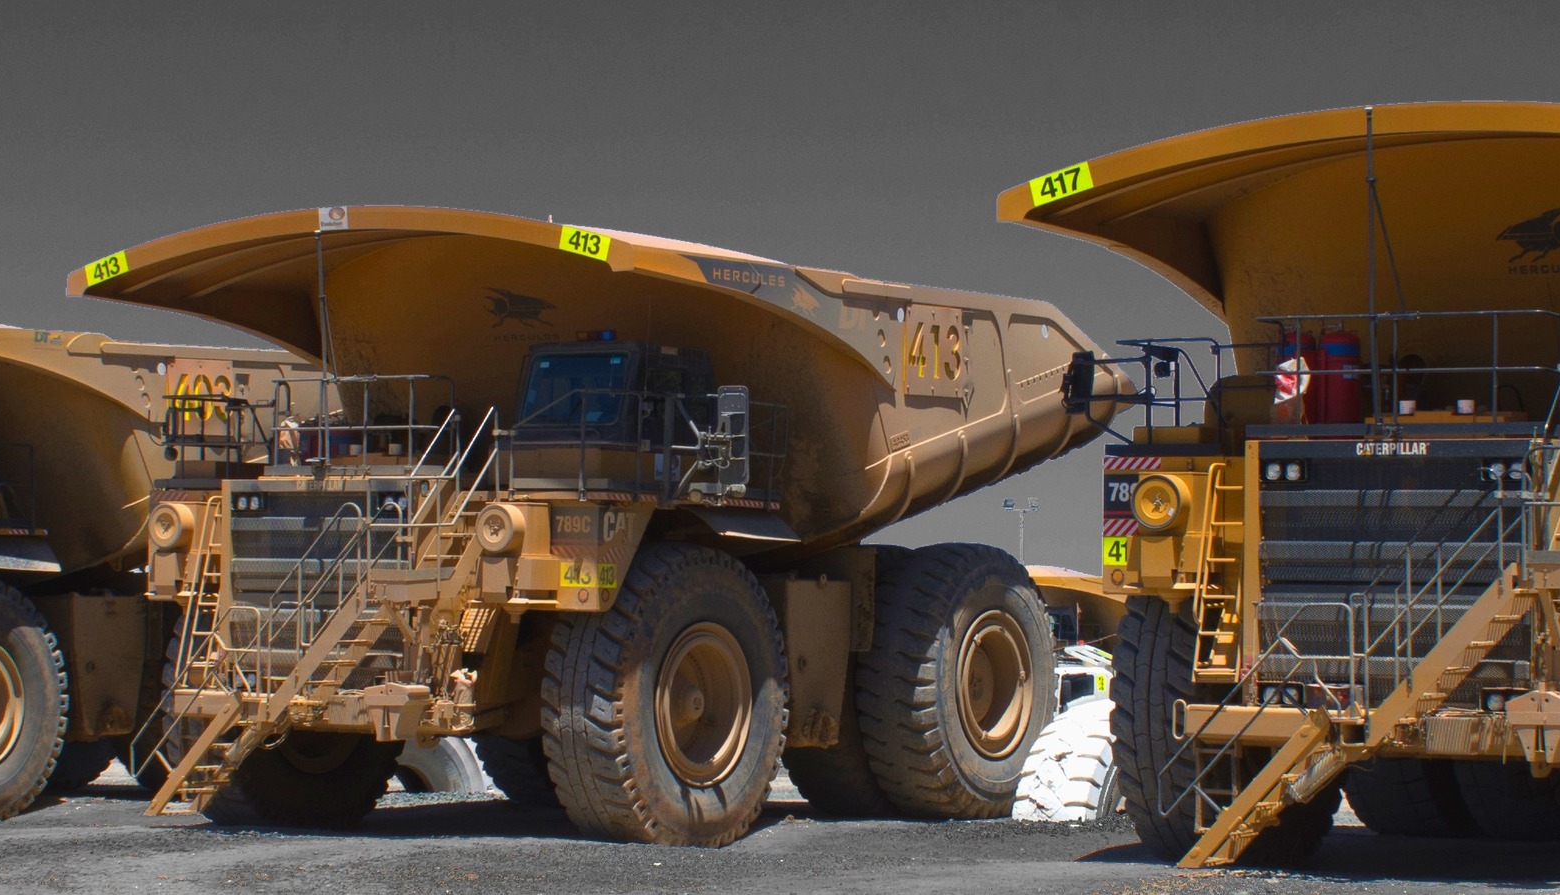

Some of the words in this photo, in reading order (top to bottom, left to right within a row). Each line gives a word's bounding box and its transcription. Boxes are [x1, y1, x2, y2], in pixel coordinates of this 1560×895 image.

[1040, 166, 1081, 198] 417
[568, 230, 601, 255] 413
[93, 256, 121, 281] 413
[712, 268, 786, 288] HERCULES
[908, 321, 962, 381] 413
[174, 373, 231, 423] 403
[1355, 442, 1427, 456] CATERPILLAR
[554, 515, 592, 533] 789C
[602, 511, 637, 543] CAT
[563, 564, 592, 585] 413
